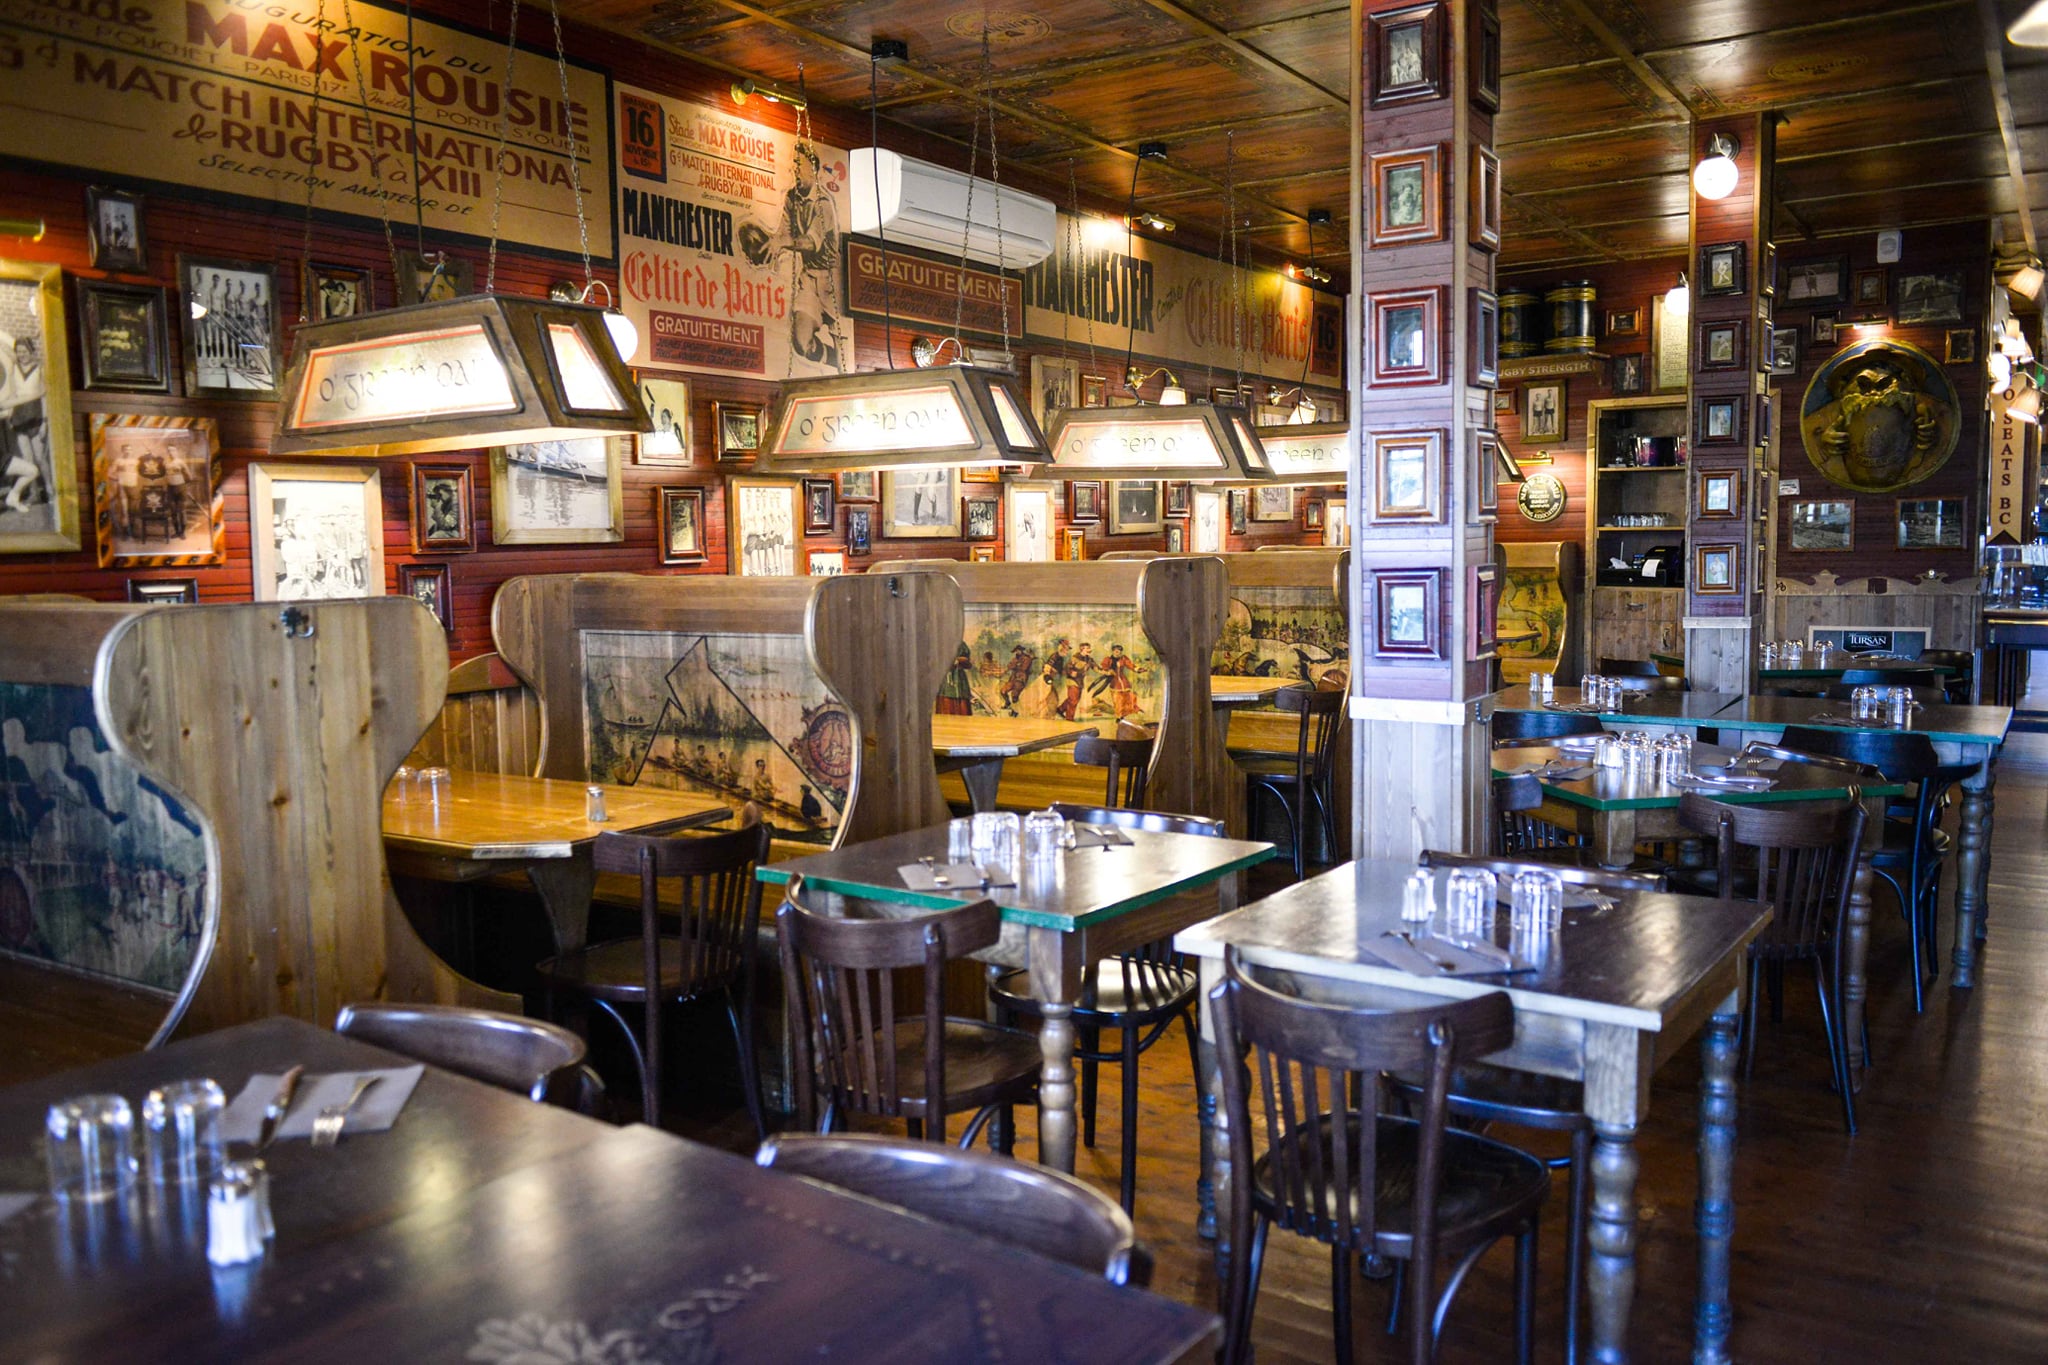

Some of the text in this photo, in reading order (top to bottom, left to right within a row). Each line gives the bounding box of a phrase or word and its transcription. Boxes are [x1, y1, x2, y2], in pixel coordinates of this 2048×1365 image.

[185, 0, 349, 82] MAX
[245, 61, 313, 88] PARIS
[445, 55, 492, 74] DU
[74, 51, 250, 119] MATCH
[627, 107, 655, 147] 16
[669, 114, 695, 140] Stade
[699, 122, 727, 149] MAX
[172, 113, 217, 144] de
[221, 119, 390, 178] RUGBY
[416, 160, 481, 198] XIII
[682, 155, 711, 174] MATCH
[712, 163, 776, 192] INTERNATIONAL
[705, 176, 735, 197] RUGBY
[622, 187, 734, 257] MANCHESTER
[622, 250, 786, 319] Celtic de Paris
[858, 253, 1014, 303] GRATUITEMENT
[1025, 240, 1154, 333] MANCHESTER
[654, 315, 760, 345] GRATUITEMENT
[1317, 314, 1336, 351] 16
[1498, 362, 1589, 377] UGBY STRENGTH
[1999, 497, 2012, 525] BC
[1851, 633, 1887, 647] TURSAN
